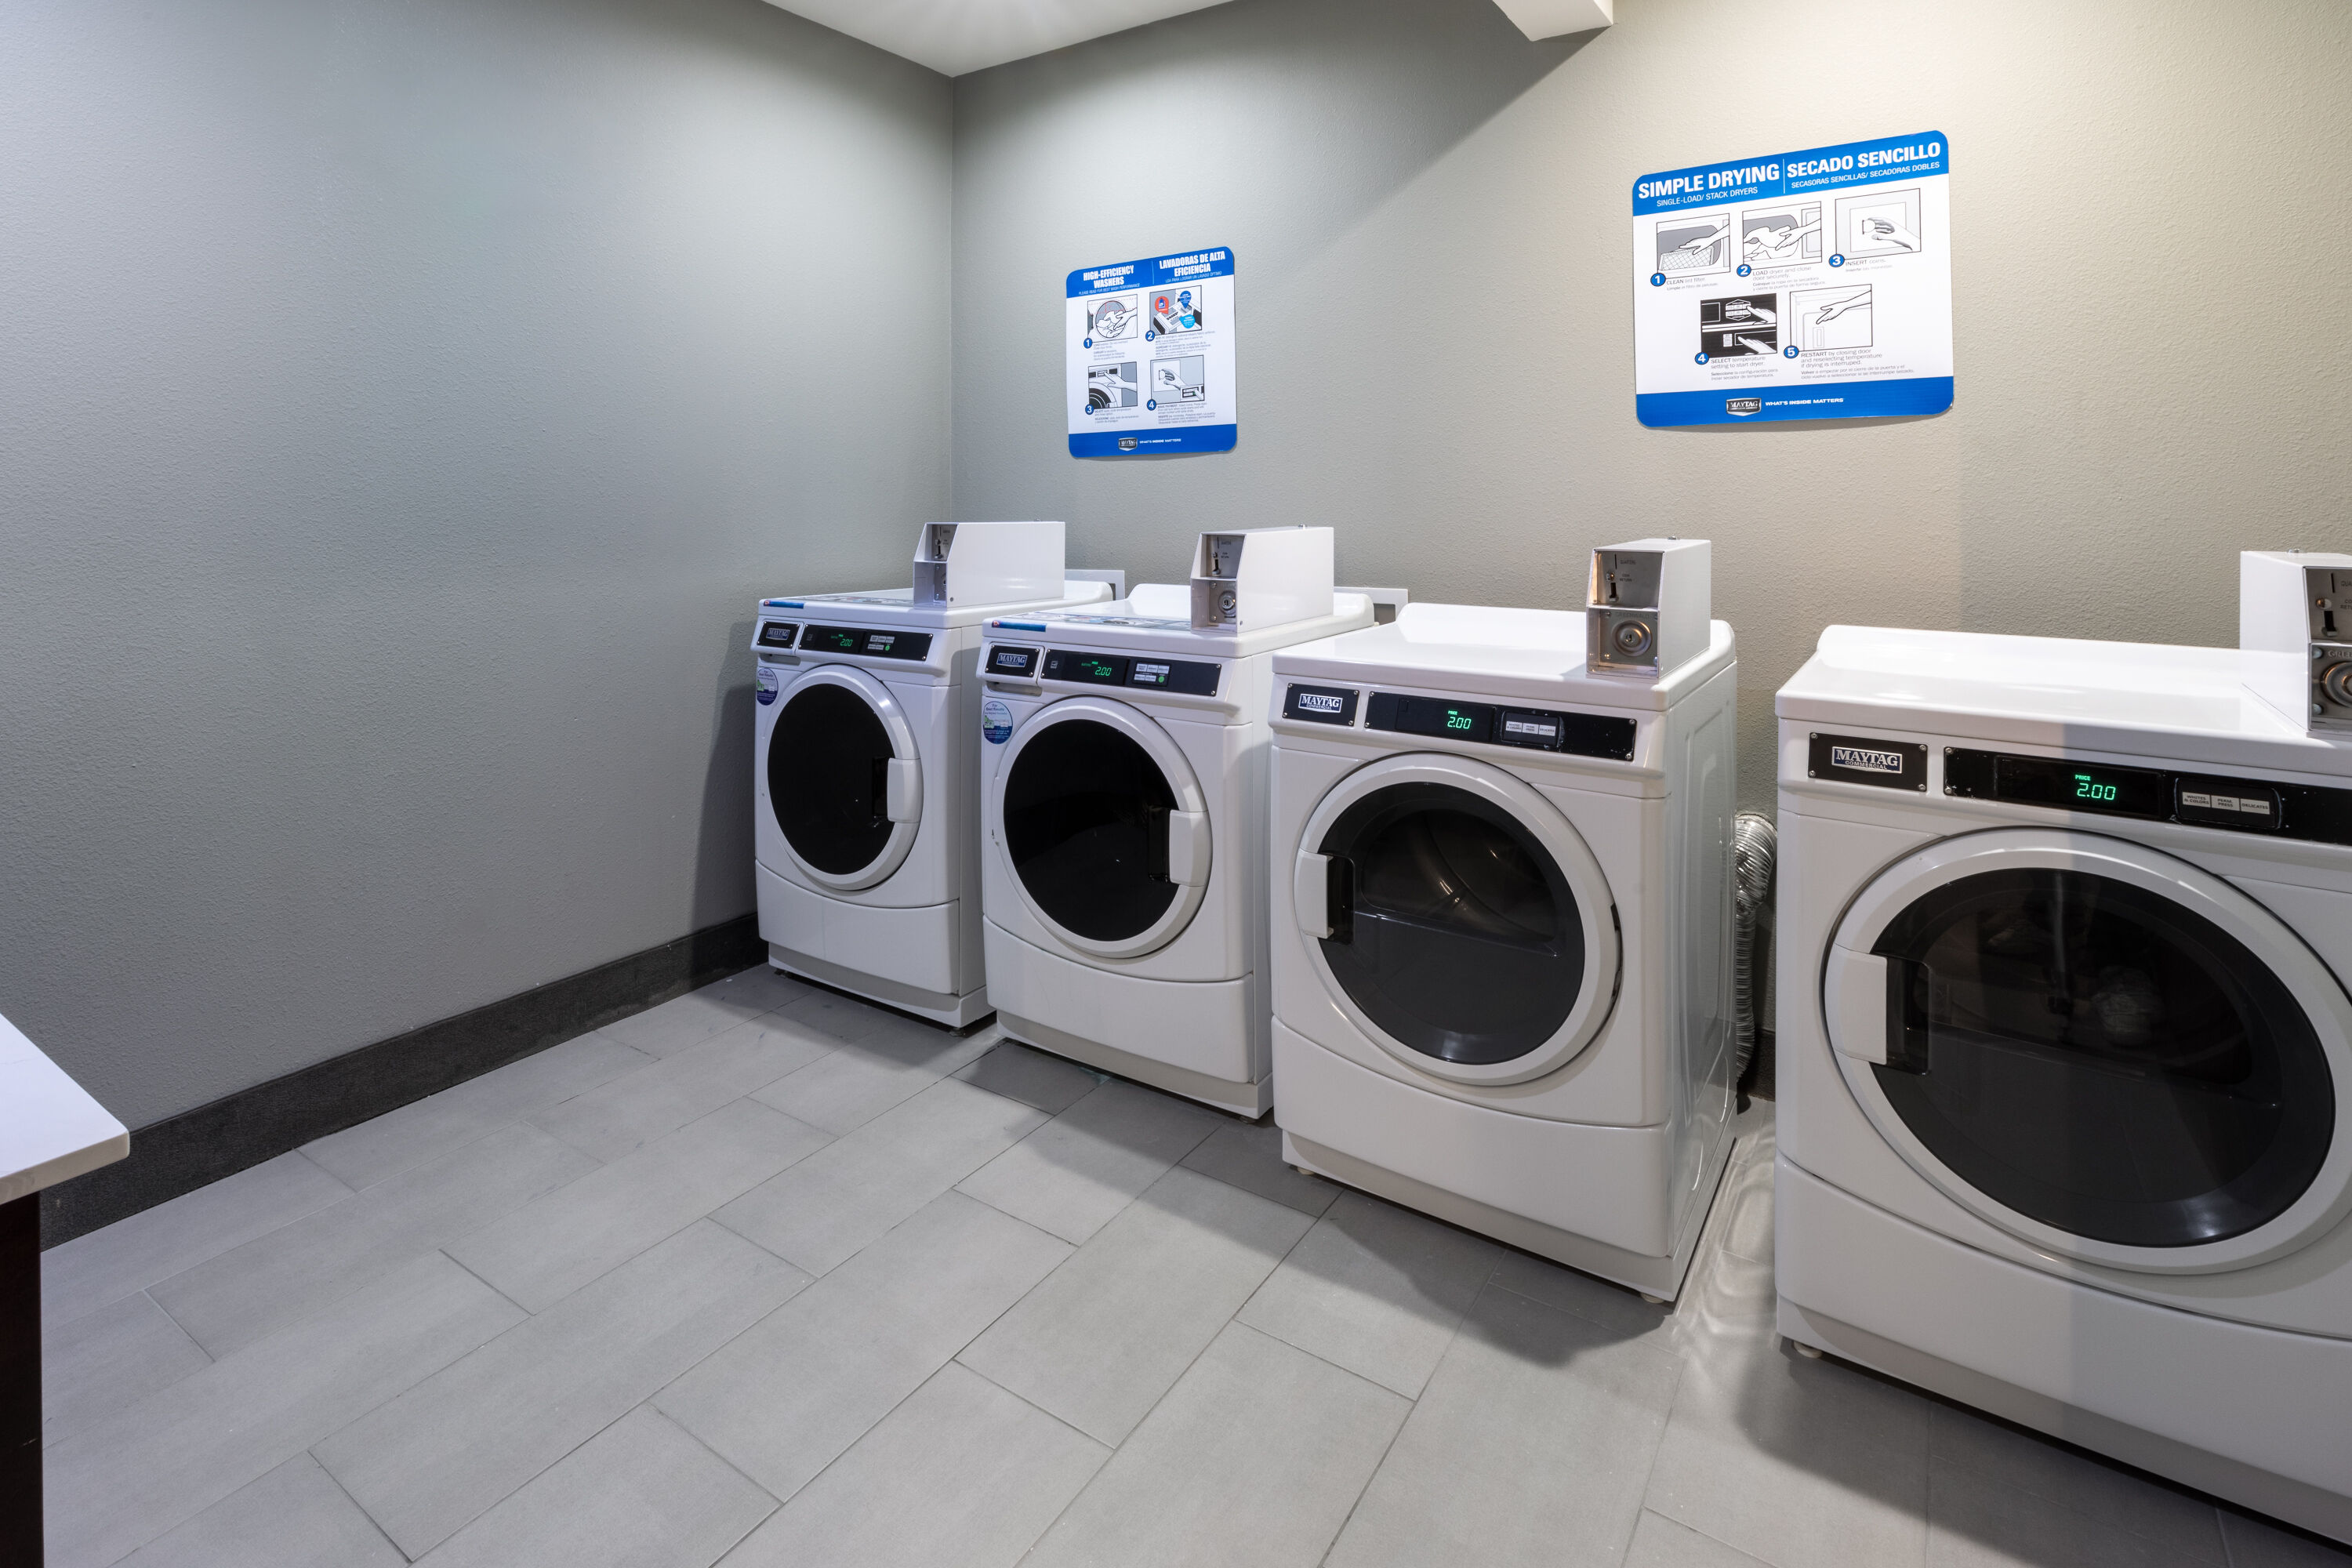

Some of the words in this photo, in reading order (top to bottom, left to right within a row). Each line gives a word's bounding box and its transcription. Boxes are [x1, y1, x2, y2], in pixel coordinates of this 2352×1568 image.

[1787, 155, 1853, 178] SECADO
[1857, 142, 1940, 168] SENCILLO
[1639, 175, 1704, 199] SIMPLE
[1708, 164, 1780, 189] DRYING
[1791, 177, 1829, 189] SECASORAS
[1831, 172, 1868, 183] SENCILLAS/
[1870, 166, 1911, 177] SECADORAS
[1912, 162, 1940, 171] DOBLES
[1657, 194, 1704, 207] SINGLE-LOAD/
[1706, 191, 1728, 201] STACK
[1730, 187, 1758, 197] DRYERS
[1159, 255, 1199, 270] LAVADORAS
[1200, 253, 1208, 263] DE
[1210, 251, 1225, 262] ALTA
[1832, 256, 1841, 266] 3
[1083, 265, 1134, 281] HIGH-EFFICIENCY
[1174, 263, 1211, 277] EFICIENCIA
[1740, 266, 1748, 275] 2
[1094, 276, 1124, 289] WASHERS
[1655, 275, 1661, 284] 1
[1698, 354, 1706, 363] 4
[1788, 347, 1795, 357] 5
[1149, 401, 1155, 409] 4
[999, 655, 1025, 663] MAYTAG
[1094, 666, 1112, 677] 2.00
[1301, 695, 1340, 708] MAYTAG
[1447, 717, 1472, 729] 2.00
[1835, 750, 1898, 767] MAYTAG
[1845, 760, 1887, 770] COMMERCIAL
[2077, 782, 2116, 800] 2.00
